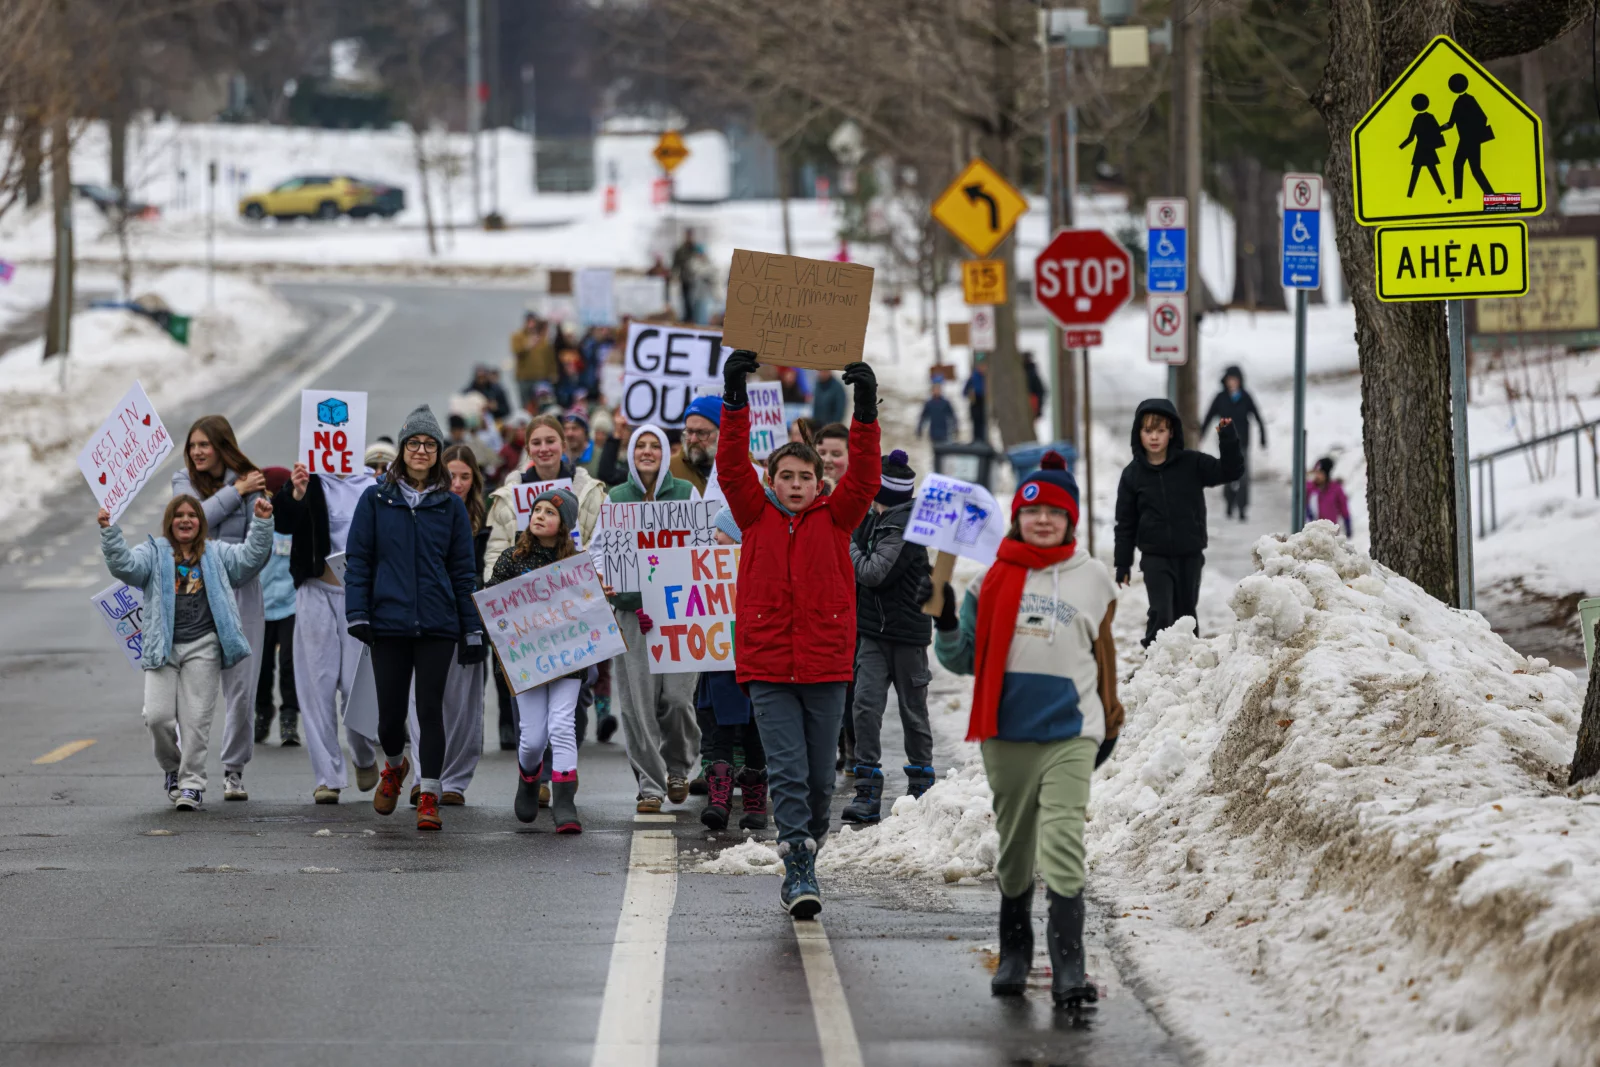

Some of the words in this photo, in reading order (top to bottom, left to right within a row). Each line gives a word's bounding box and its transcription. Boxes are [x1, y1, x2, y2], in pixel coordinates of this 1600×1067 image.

[737, 252, 787, 281] WE
[794, 261, 853, 288] VALUE
[970, 267, 999, 289] 15
[1040, 258, 1126, 298] STOP
[1396, 243, 1509, 280] AHEAD
[737, 282, 783, 307] OUR
[751, 305, 813, 330] FAMILIES
[632, 328, 723, 378] GET
[625, 380, 698, 424] OU
[92, 430, 117, 468] REST
[118, 401, 139, 435] IN
[314, 430, 347, 452] NO
[104, 476, 128, 513] RENEE
[125, 448, 149, 483] NICOLE
[146, 425, 167, 456] GOOD
[107, 431, 140, 477] POWER
[308, 449, 353, 473] ICE
[600, 502, 640, 531] FIGHT
[640, 499, 717, 531] IGNORANCE
[637, 529, 691, 550] NOT
[100, 585, 139, 620] WE
[485, 561, 596, 618] IMMIGRANTS
[535, 640, 598, 674] Great
